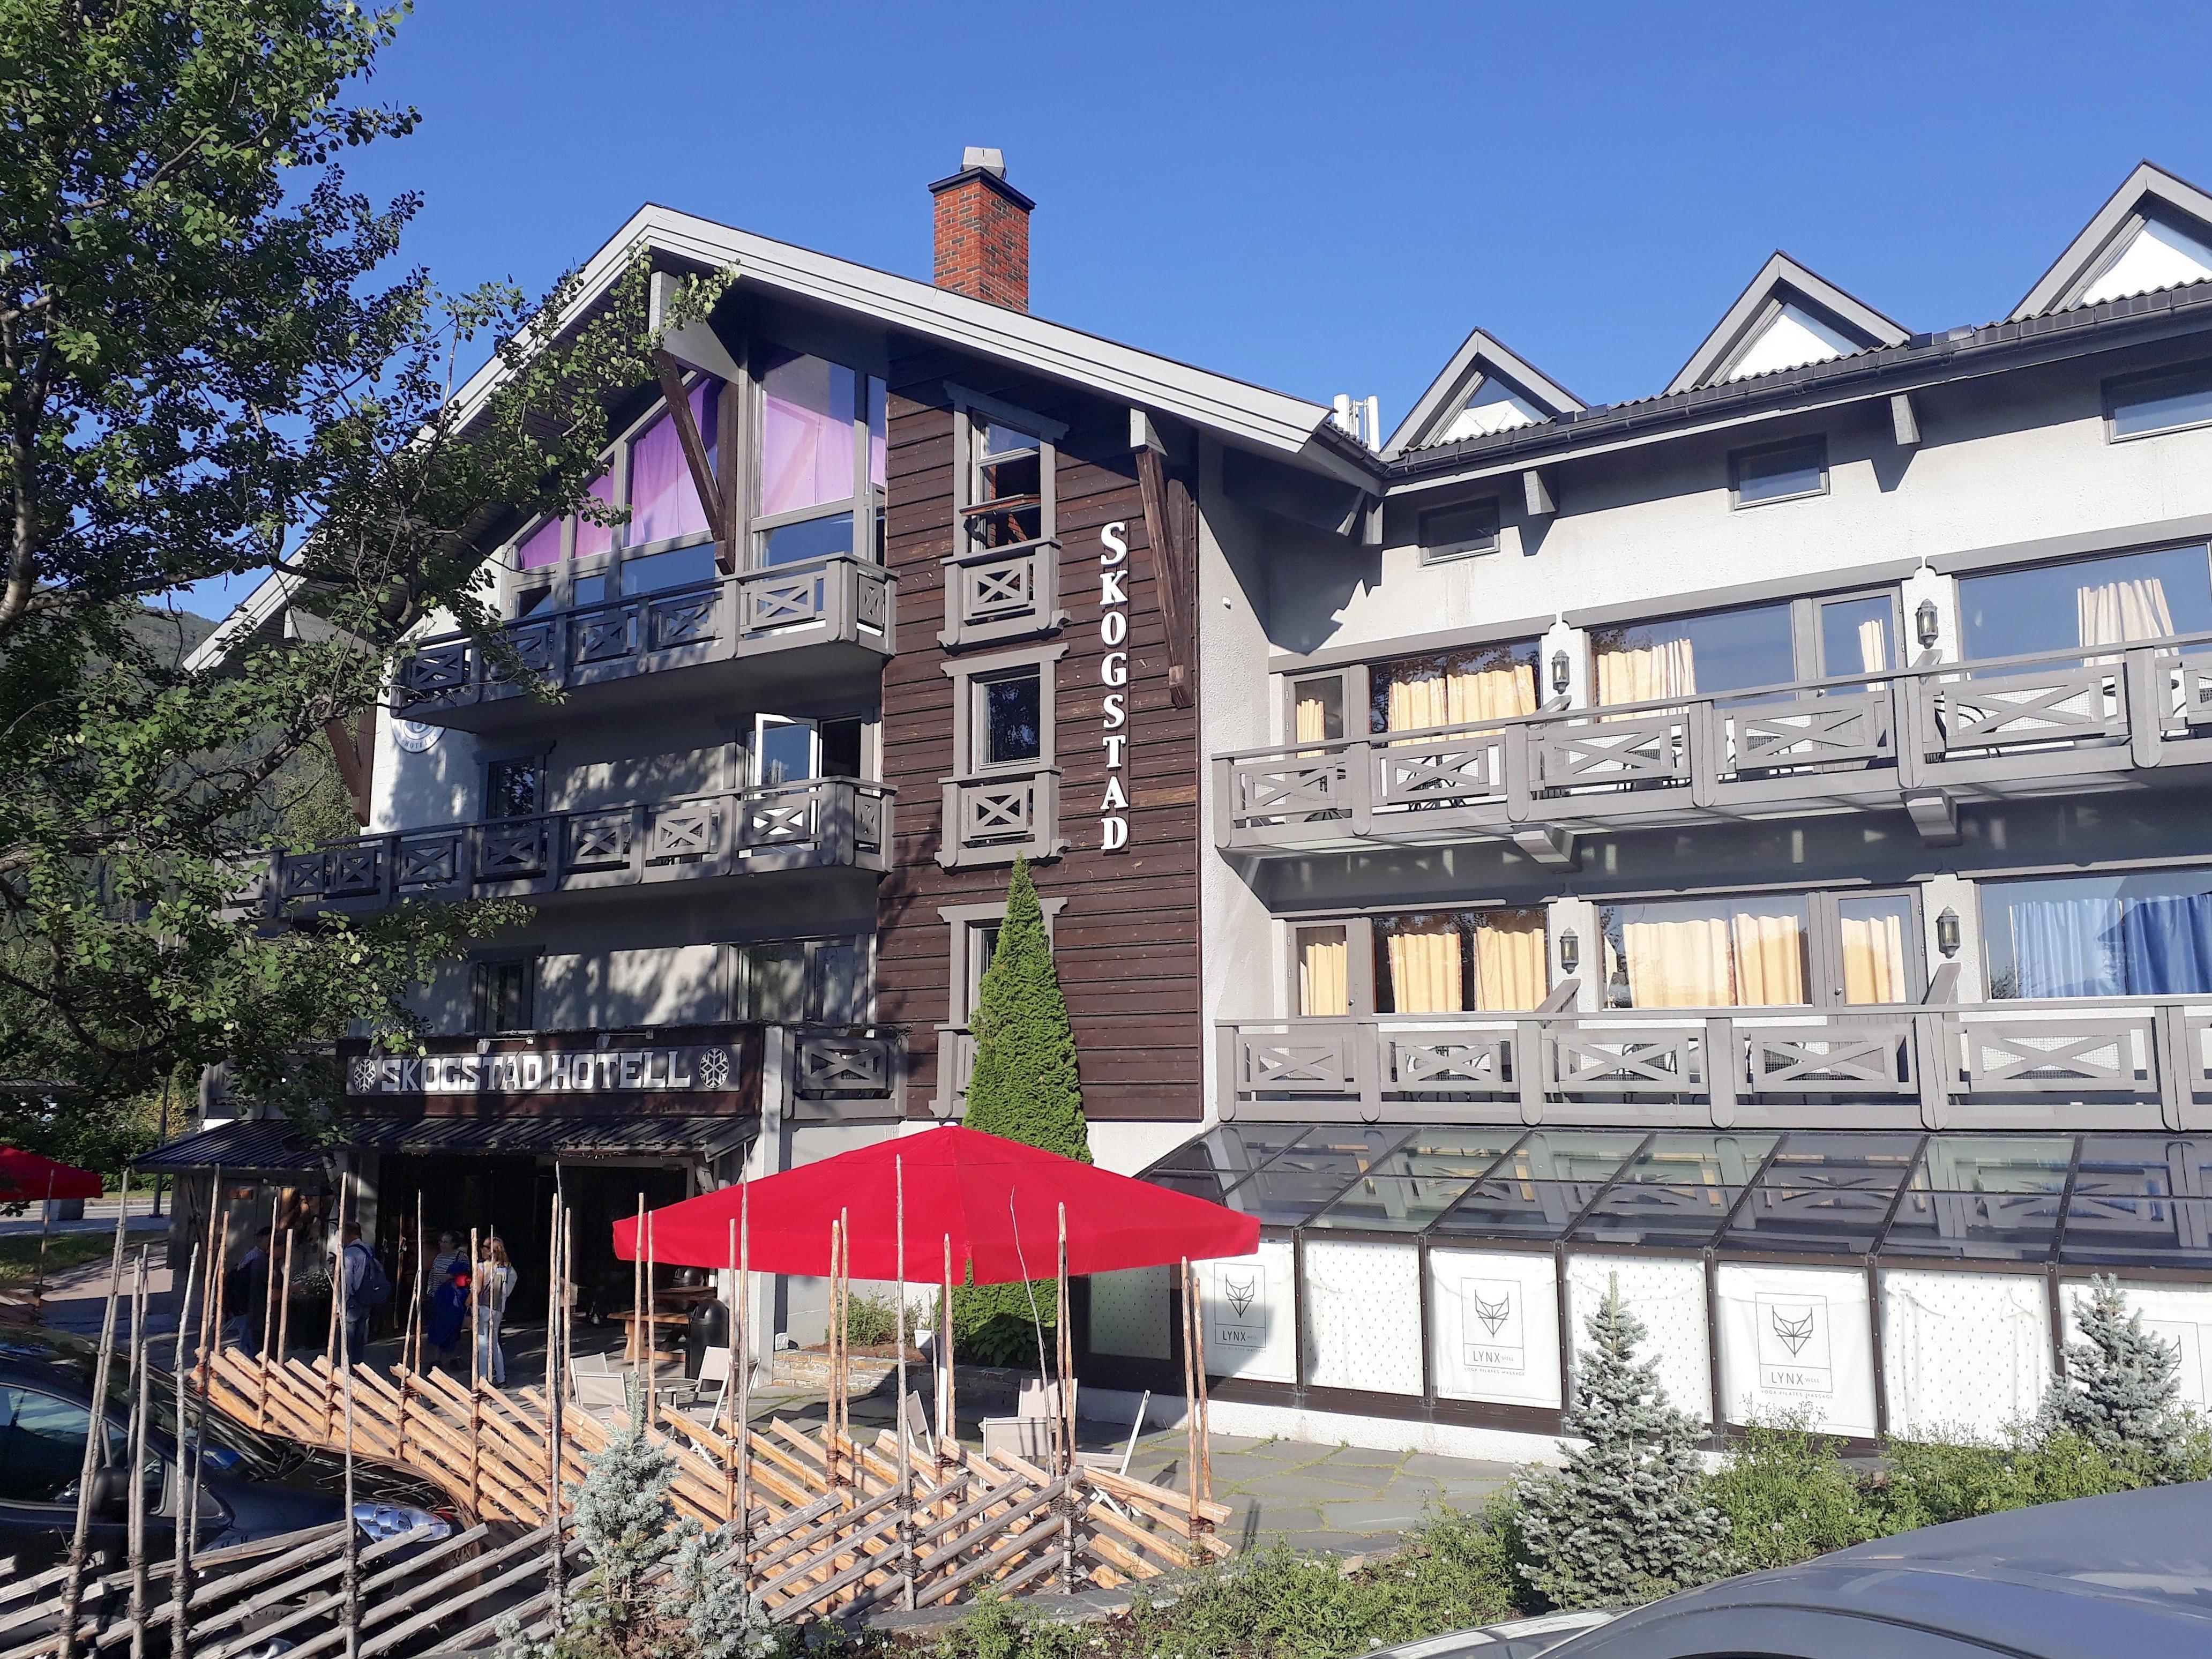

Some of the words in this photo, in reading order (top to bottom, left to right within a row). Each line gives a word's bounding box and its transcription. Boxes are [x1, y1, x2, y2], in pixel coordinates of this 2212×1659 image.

[1100, 521, 1129, 851] SKOGSTAD
[382, 1055, 542, 1092] SKOGSTAD
[550, 1051, 691, 1090] HOTELL
[1223, 1331, 1246, 1342] LYNX
[1473, 1350, 1500, 1363] LYNX
[1772, 1372, 1803, 1385] LYNX
